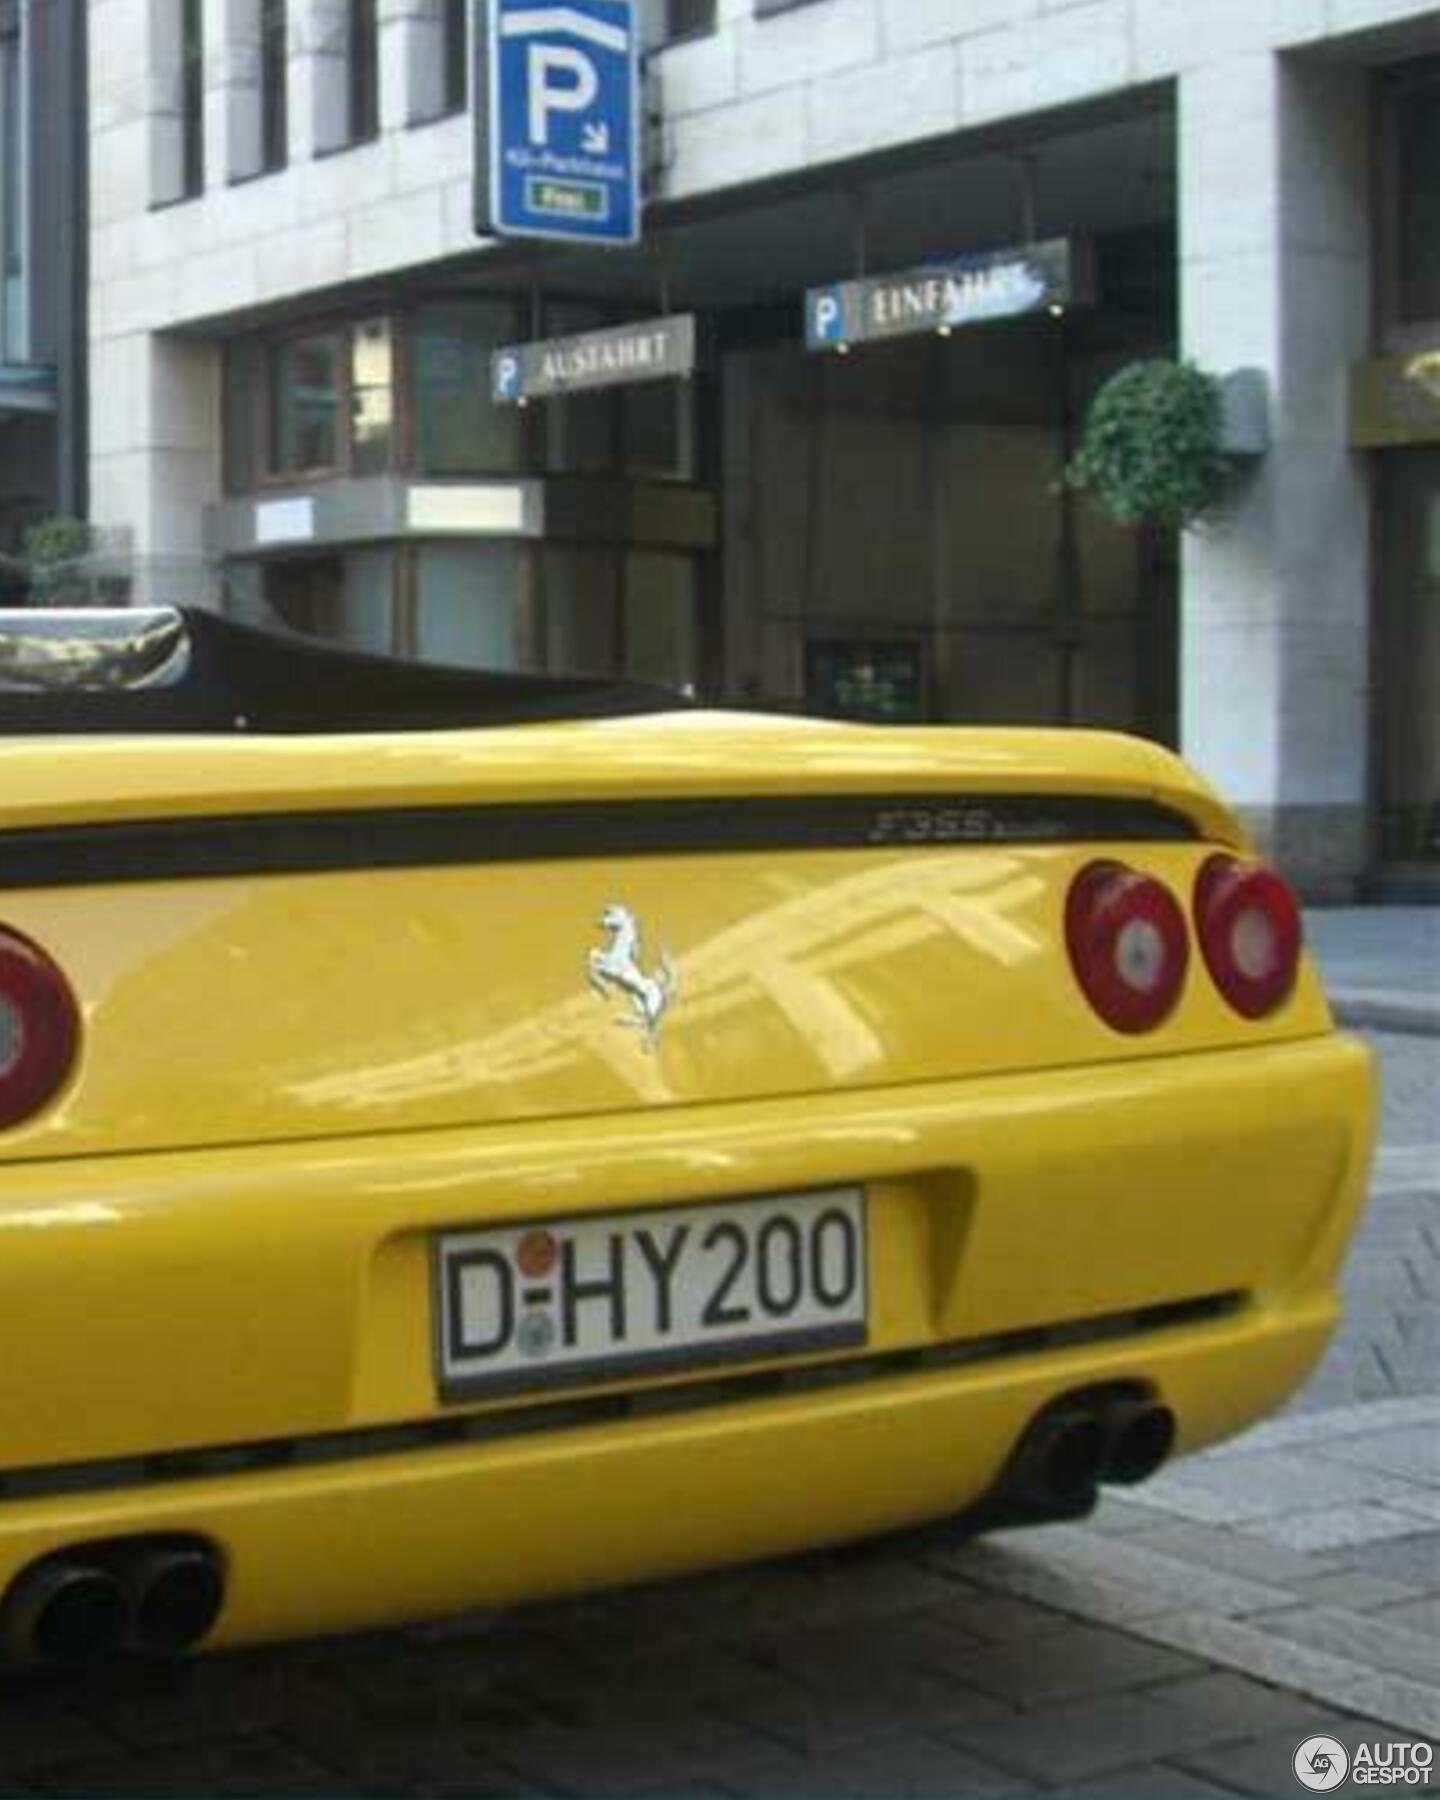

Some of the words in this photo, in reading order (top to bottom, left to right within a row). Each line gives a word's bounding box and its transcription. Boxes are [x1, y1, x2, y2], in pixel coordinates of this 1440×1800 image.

[527, 42, 599, 145] P
[816, 296, 838, 339] P
[498, 355, 517, 396] P
[541, 332, 668, 380] AUSFAHRT
